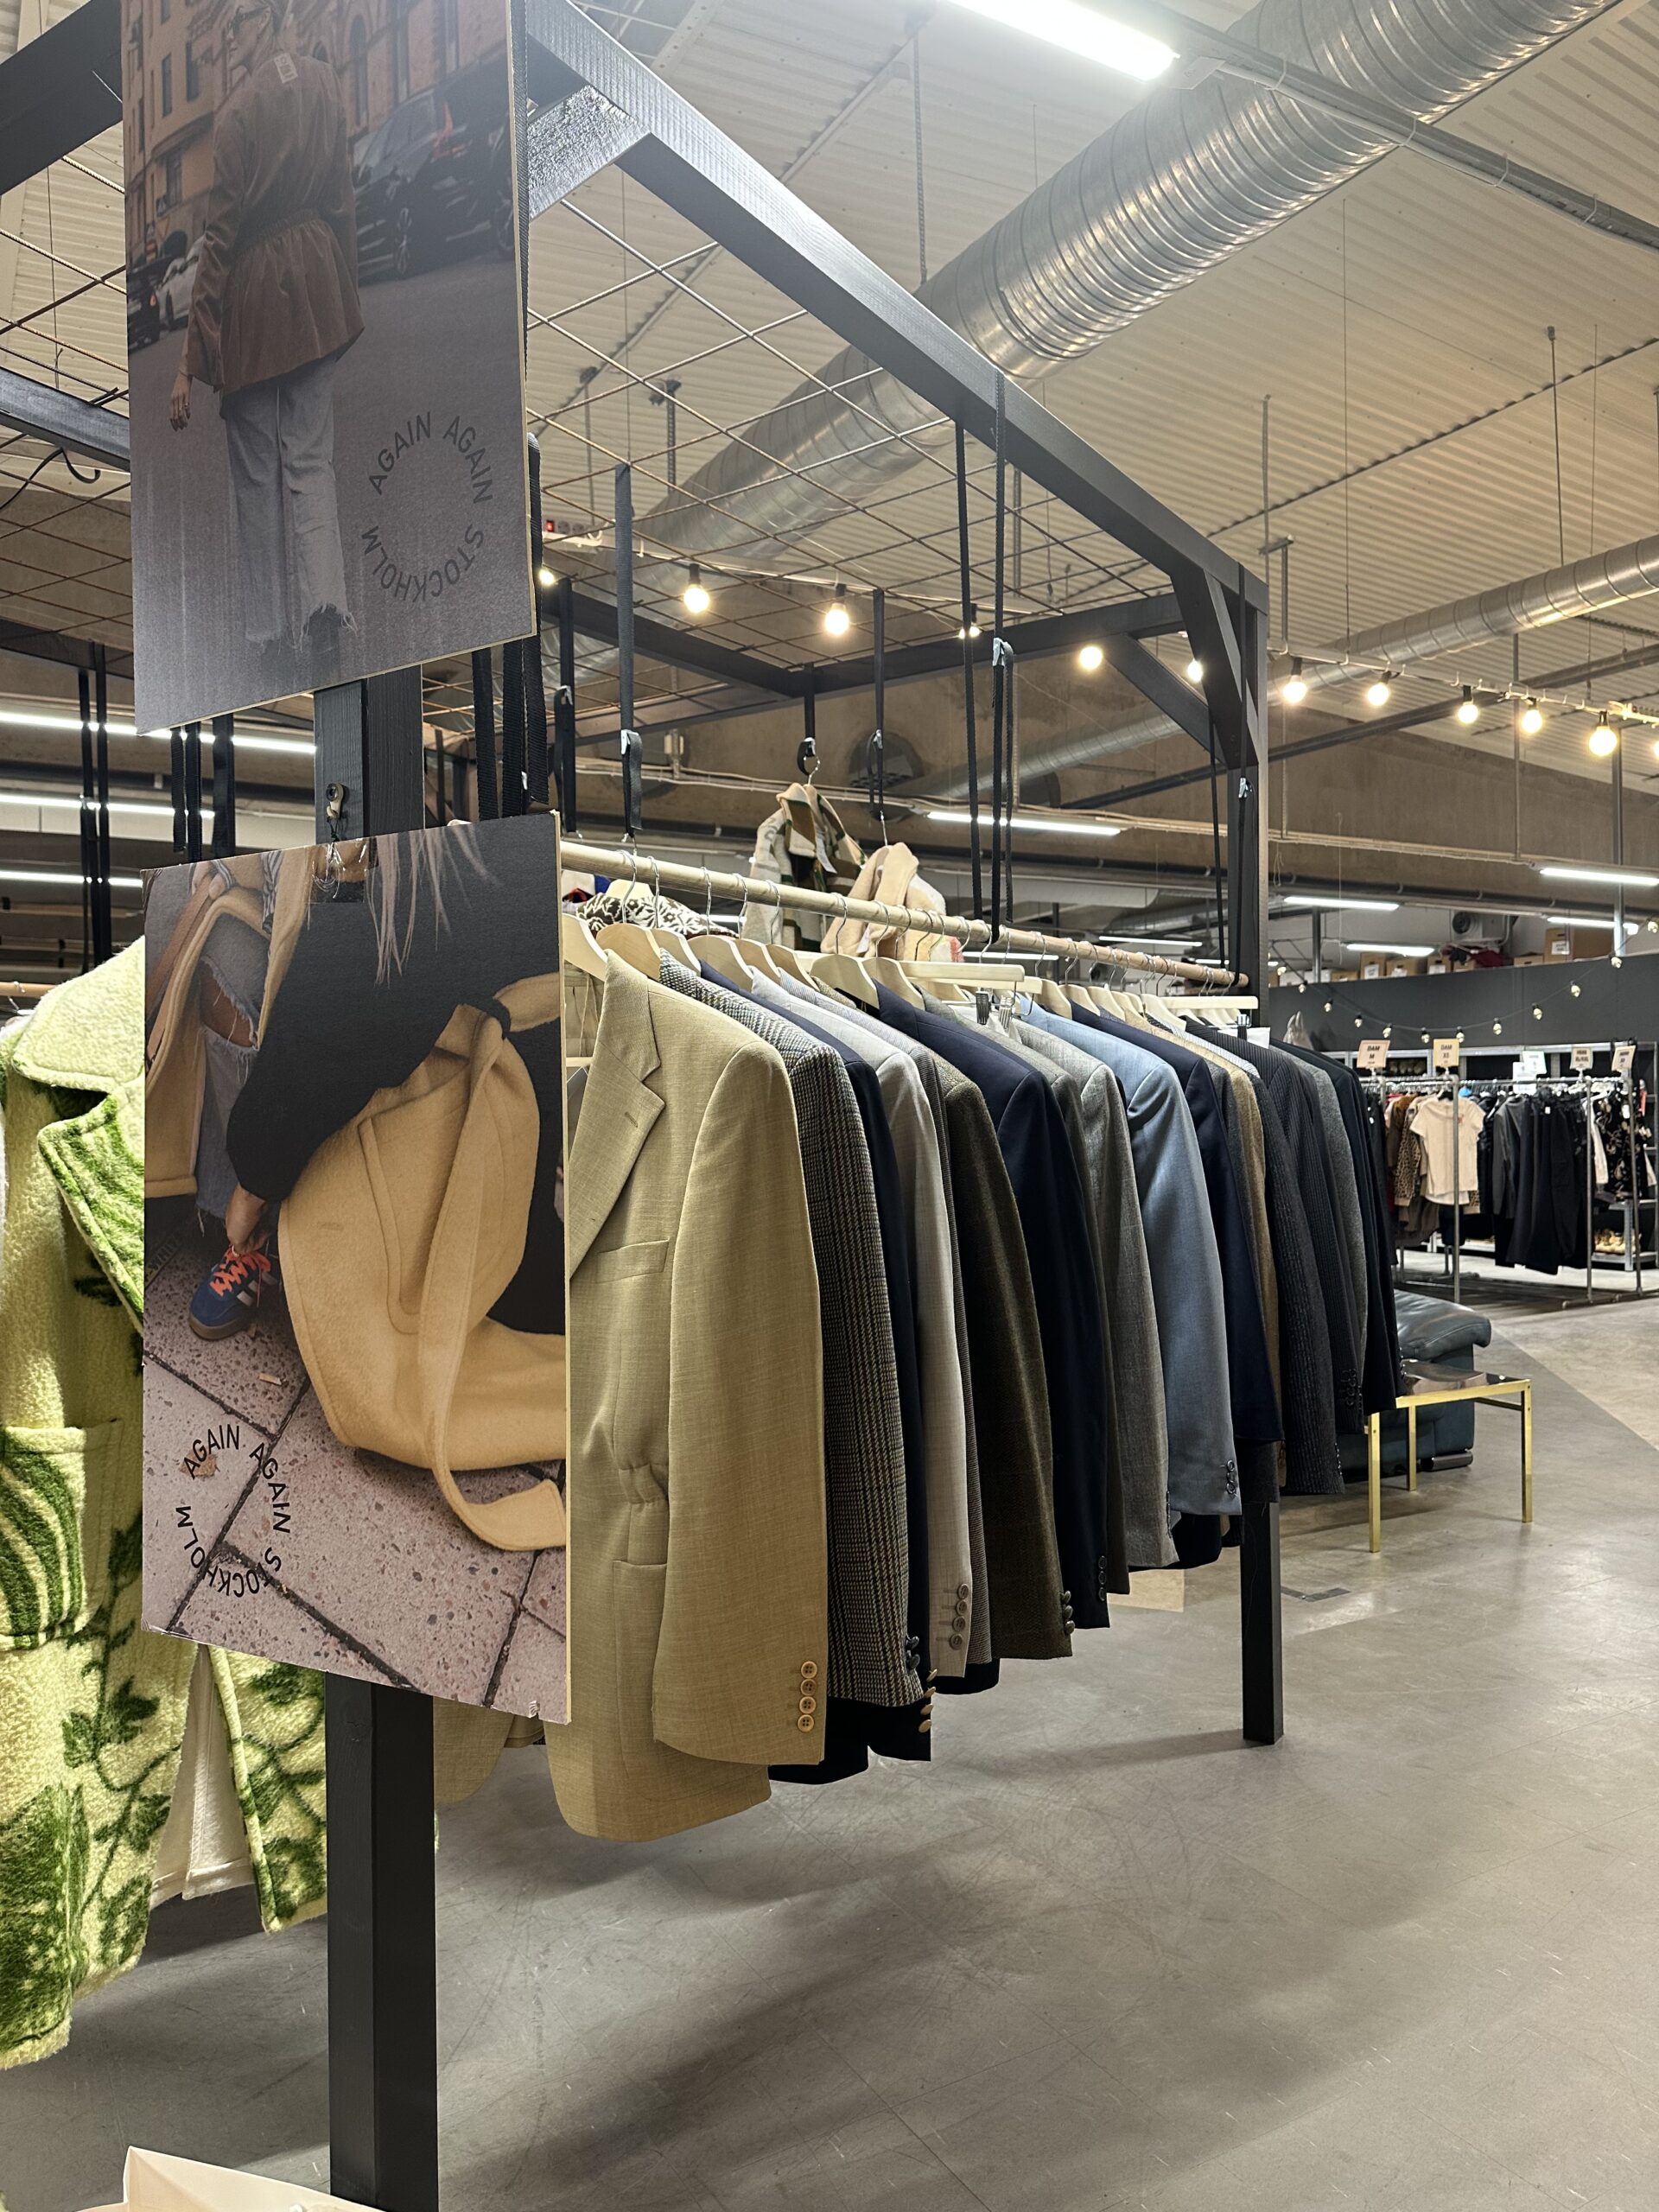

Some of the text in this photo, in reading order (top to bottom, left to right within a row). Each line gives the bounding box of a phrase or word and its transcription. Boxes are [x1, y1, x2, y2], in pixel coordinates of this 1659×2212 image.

[369, 411, 493, 504] AGAIN AGAIN
[361, 524, 485, 603] STOCKHOLM
[183, 1423, 291, 1534] AGAIN AGAIN
[175, 1505, 283, 1598] STOCKHOLM
